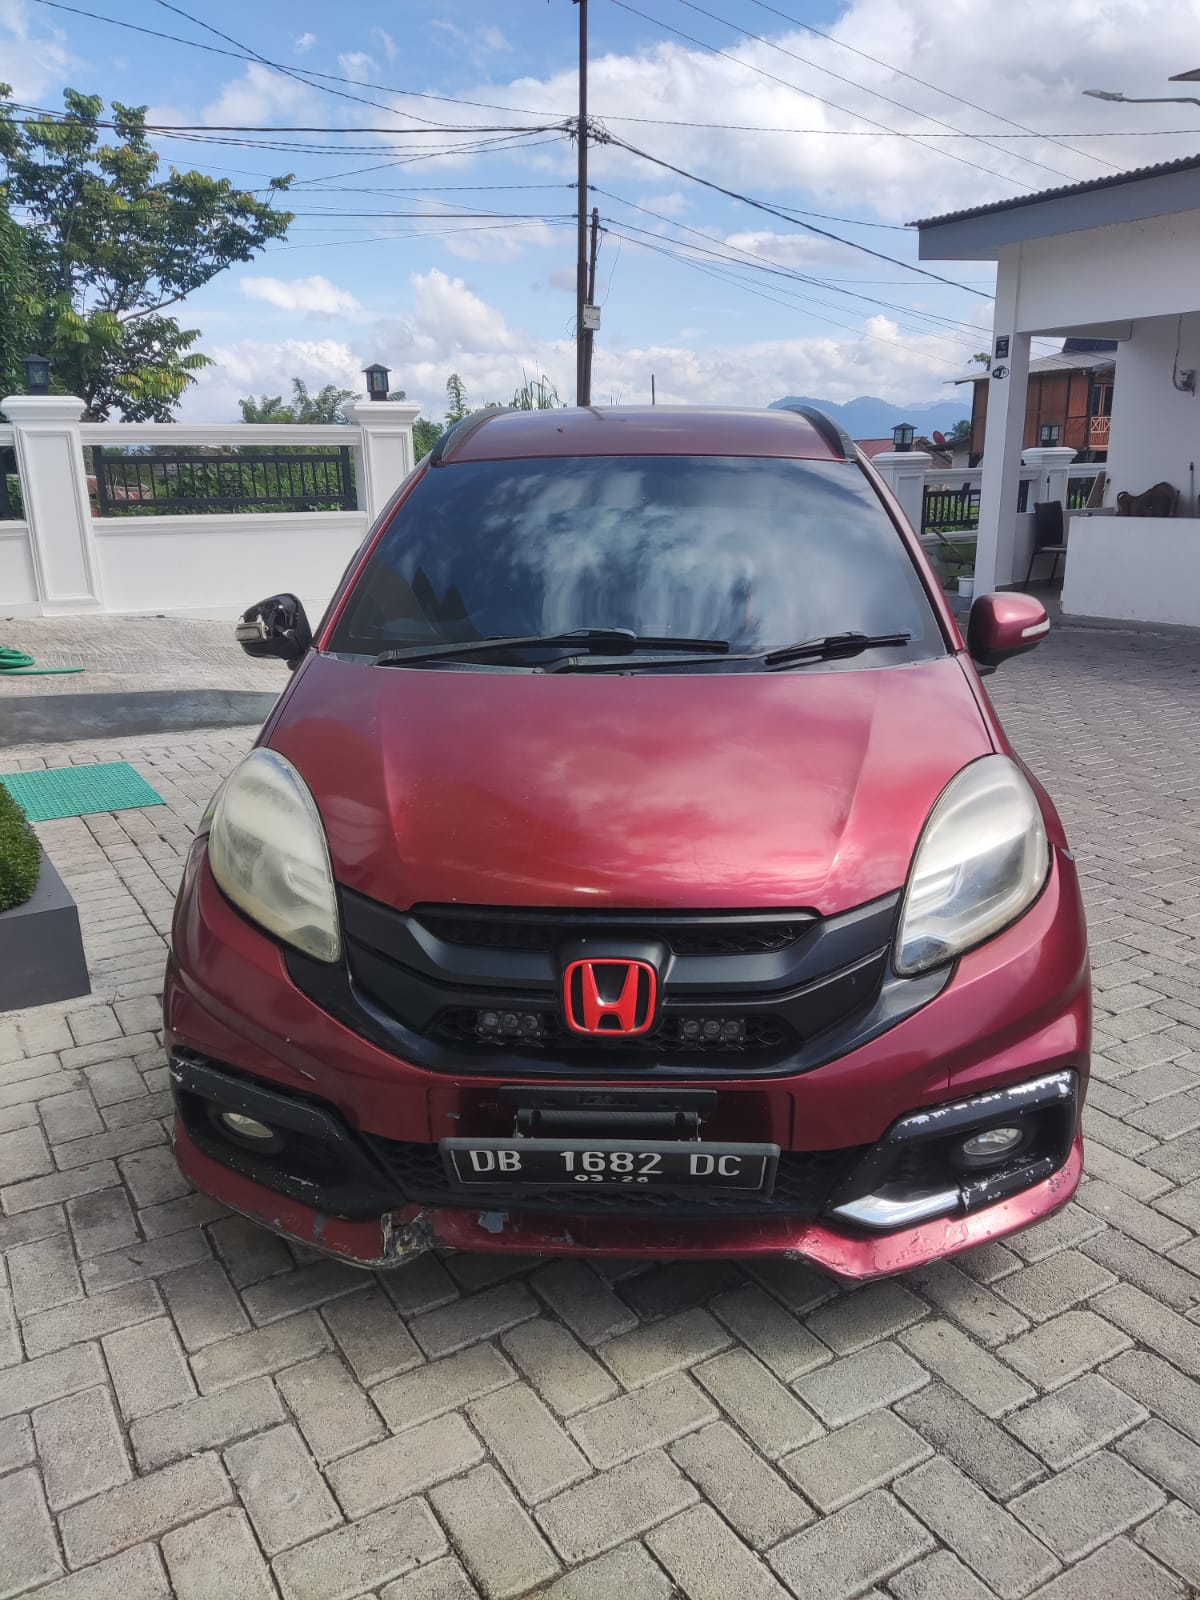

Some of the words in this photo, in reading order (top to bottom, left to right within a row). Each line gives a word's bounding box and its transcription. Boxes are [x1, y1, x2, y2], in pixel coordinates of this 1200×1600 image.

[469, 1150, 522, 1172] DB
[560, 1151, 663, 1175] 1682
[690, 1153, 742, 1176] DC
